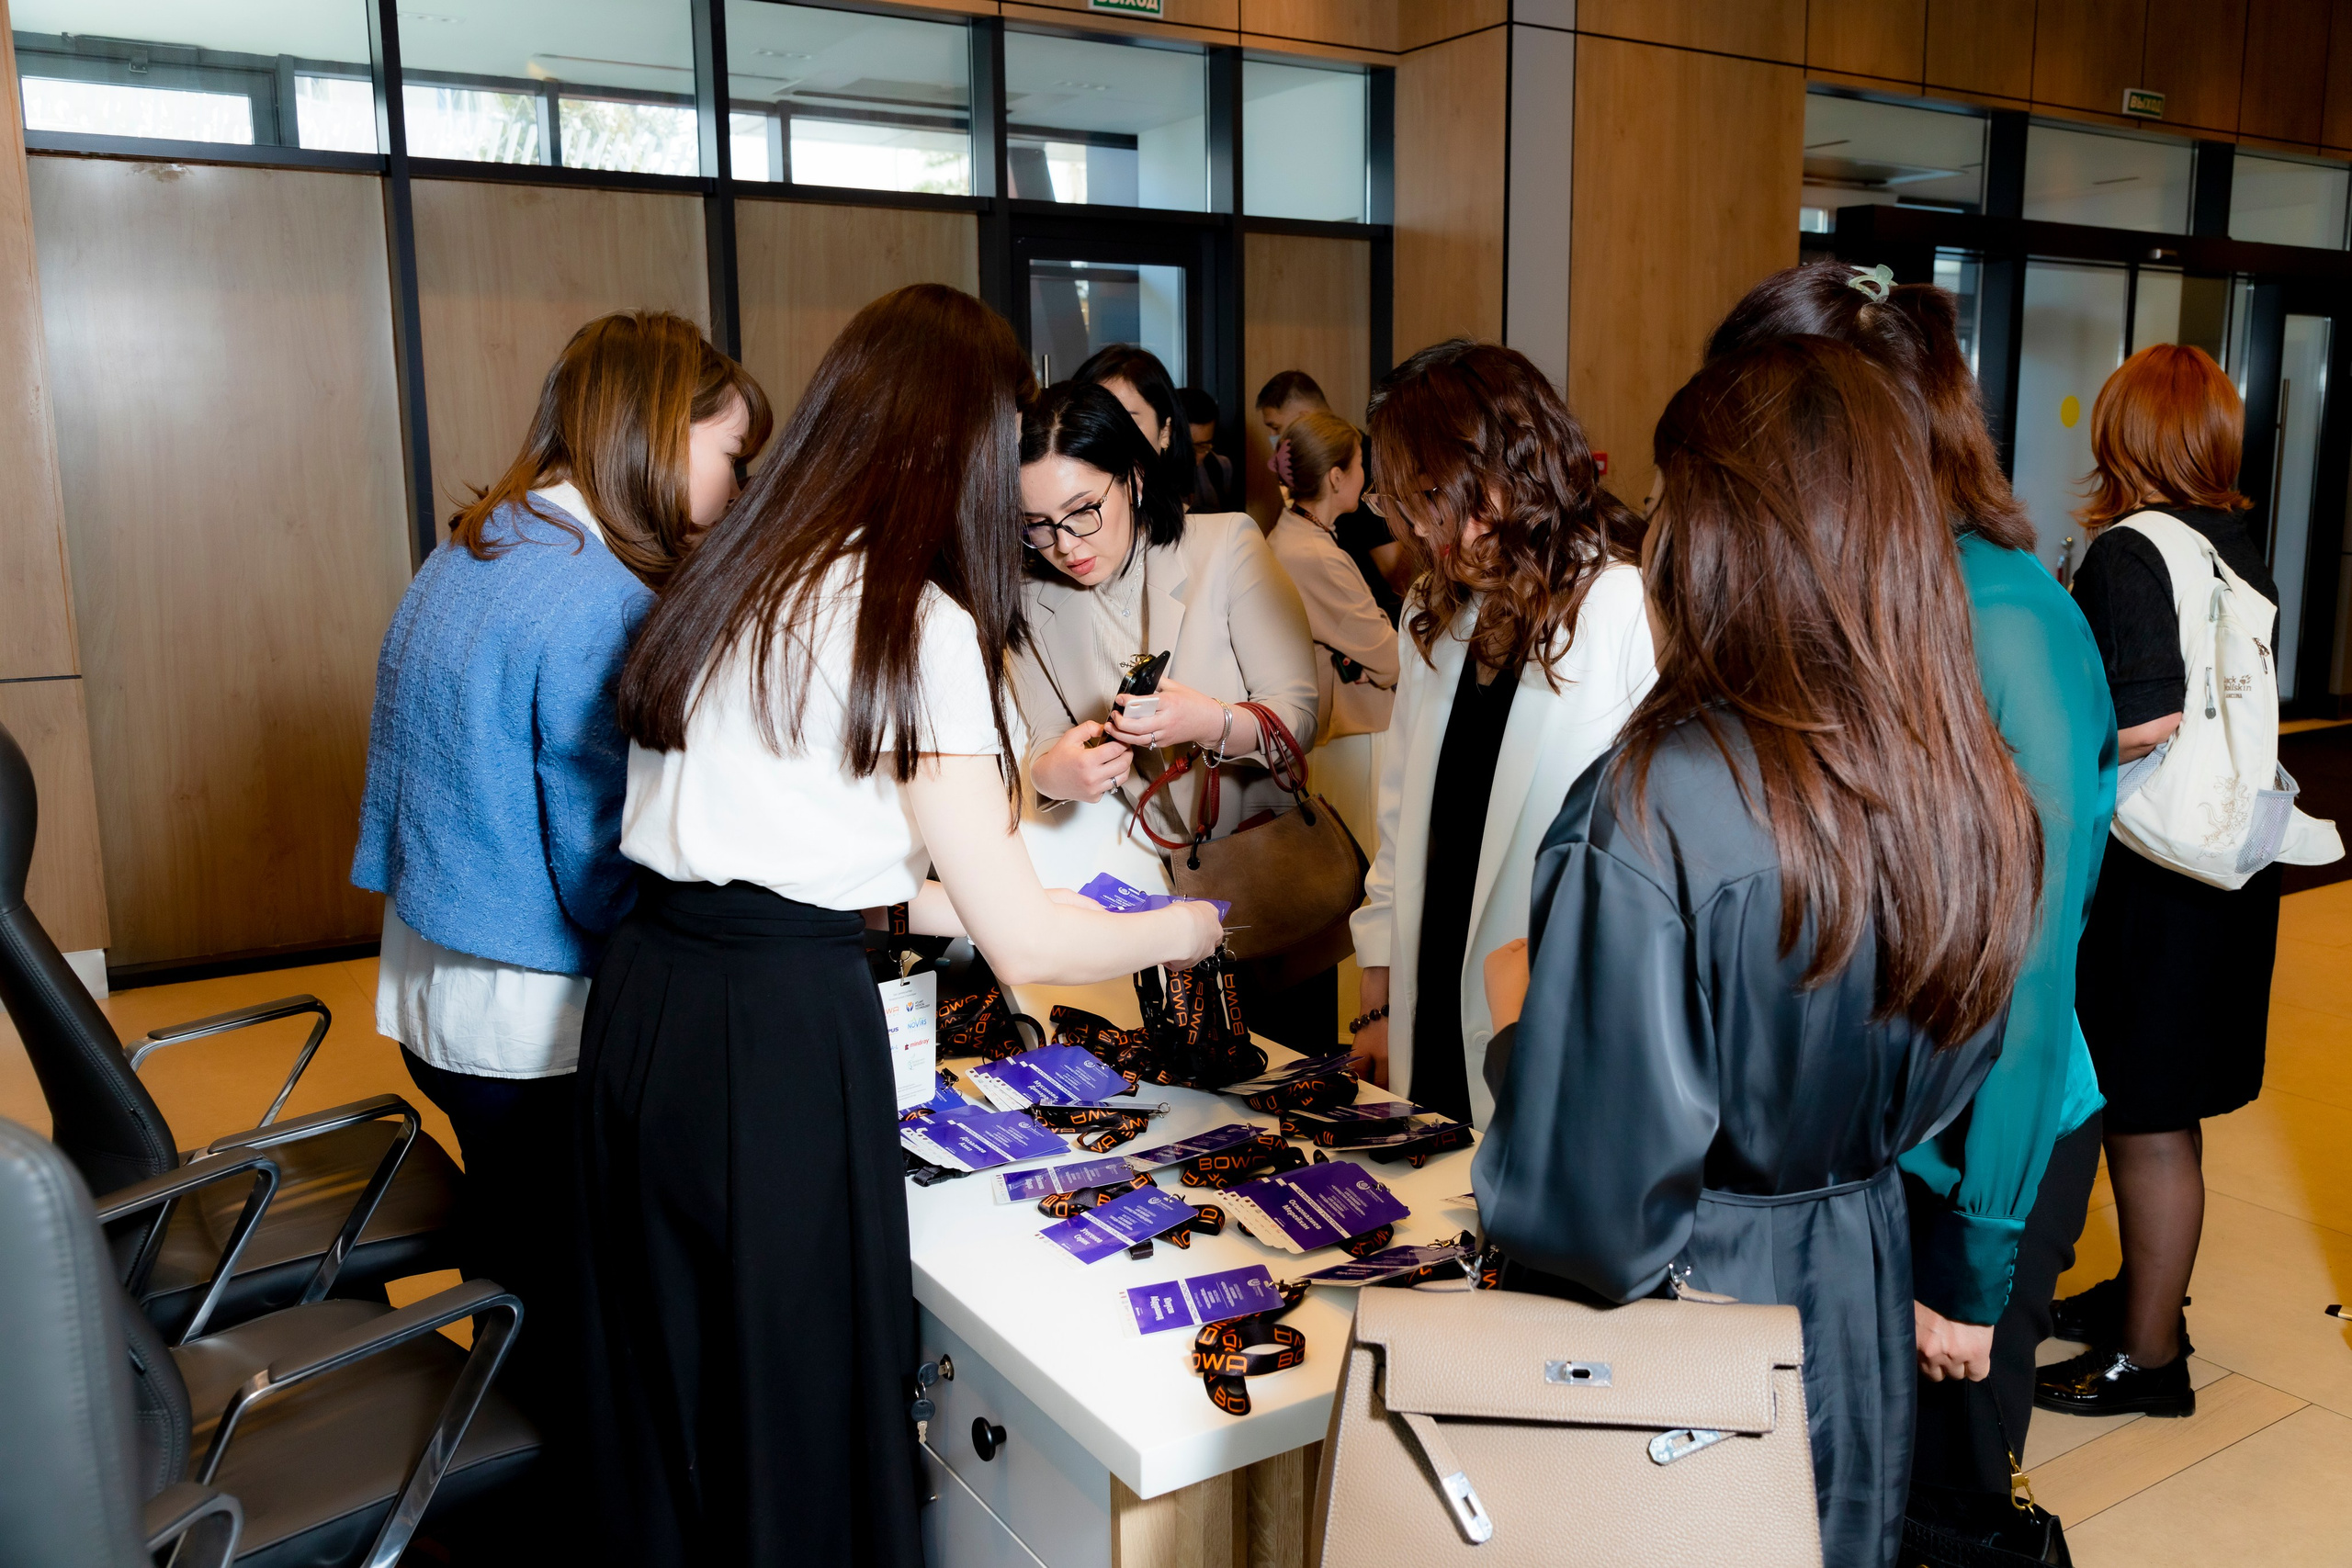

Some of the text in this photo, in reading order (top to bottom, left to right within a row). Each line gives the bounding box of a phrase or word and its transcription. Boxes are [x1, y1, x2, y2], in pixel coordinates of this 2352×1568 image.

[1188, 981, 1204, 1044] BOWA
[1225, 974, 1245, 1036] BOWA
[1282, 1204, 1310, 1230] Мерейхан
[1288, 1199, 1322, 1230] Осмоналиев
[1074, 1234, 1091, 1247] Серик
